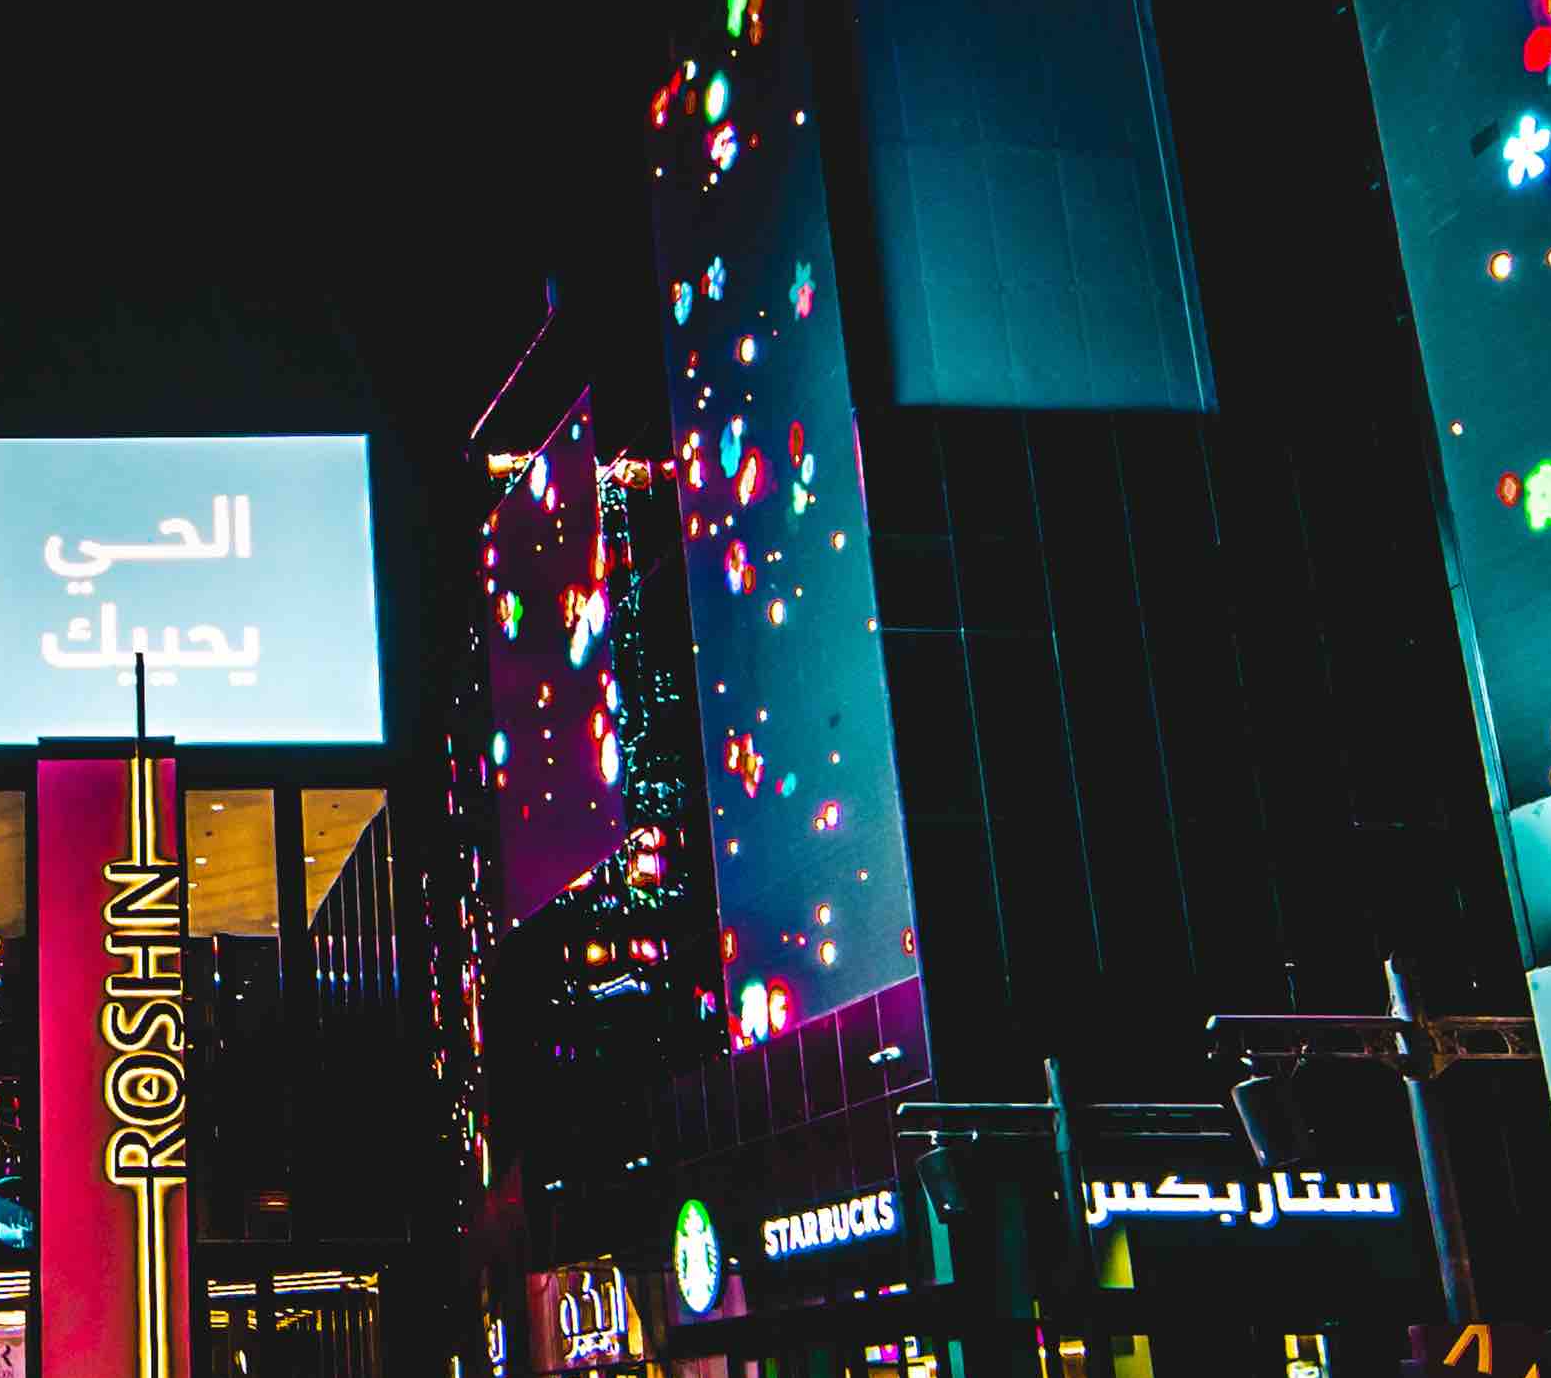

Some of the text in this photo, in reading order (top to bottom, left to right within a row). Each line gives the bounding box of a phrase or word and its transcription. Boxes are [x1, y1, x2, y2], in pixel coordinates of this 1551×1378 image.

[43, 495, 252, 595] الحي
[40, 602, 261, 685] يحييك
[102, 862, 185, 1184] ROSHN
[763, 1190, 896, 1257] STARBUCKS
[1082, 1170, 1394, 1226] ستاربكس
